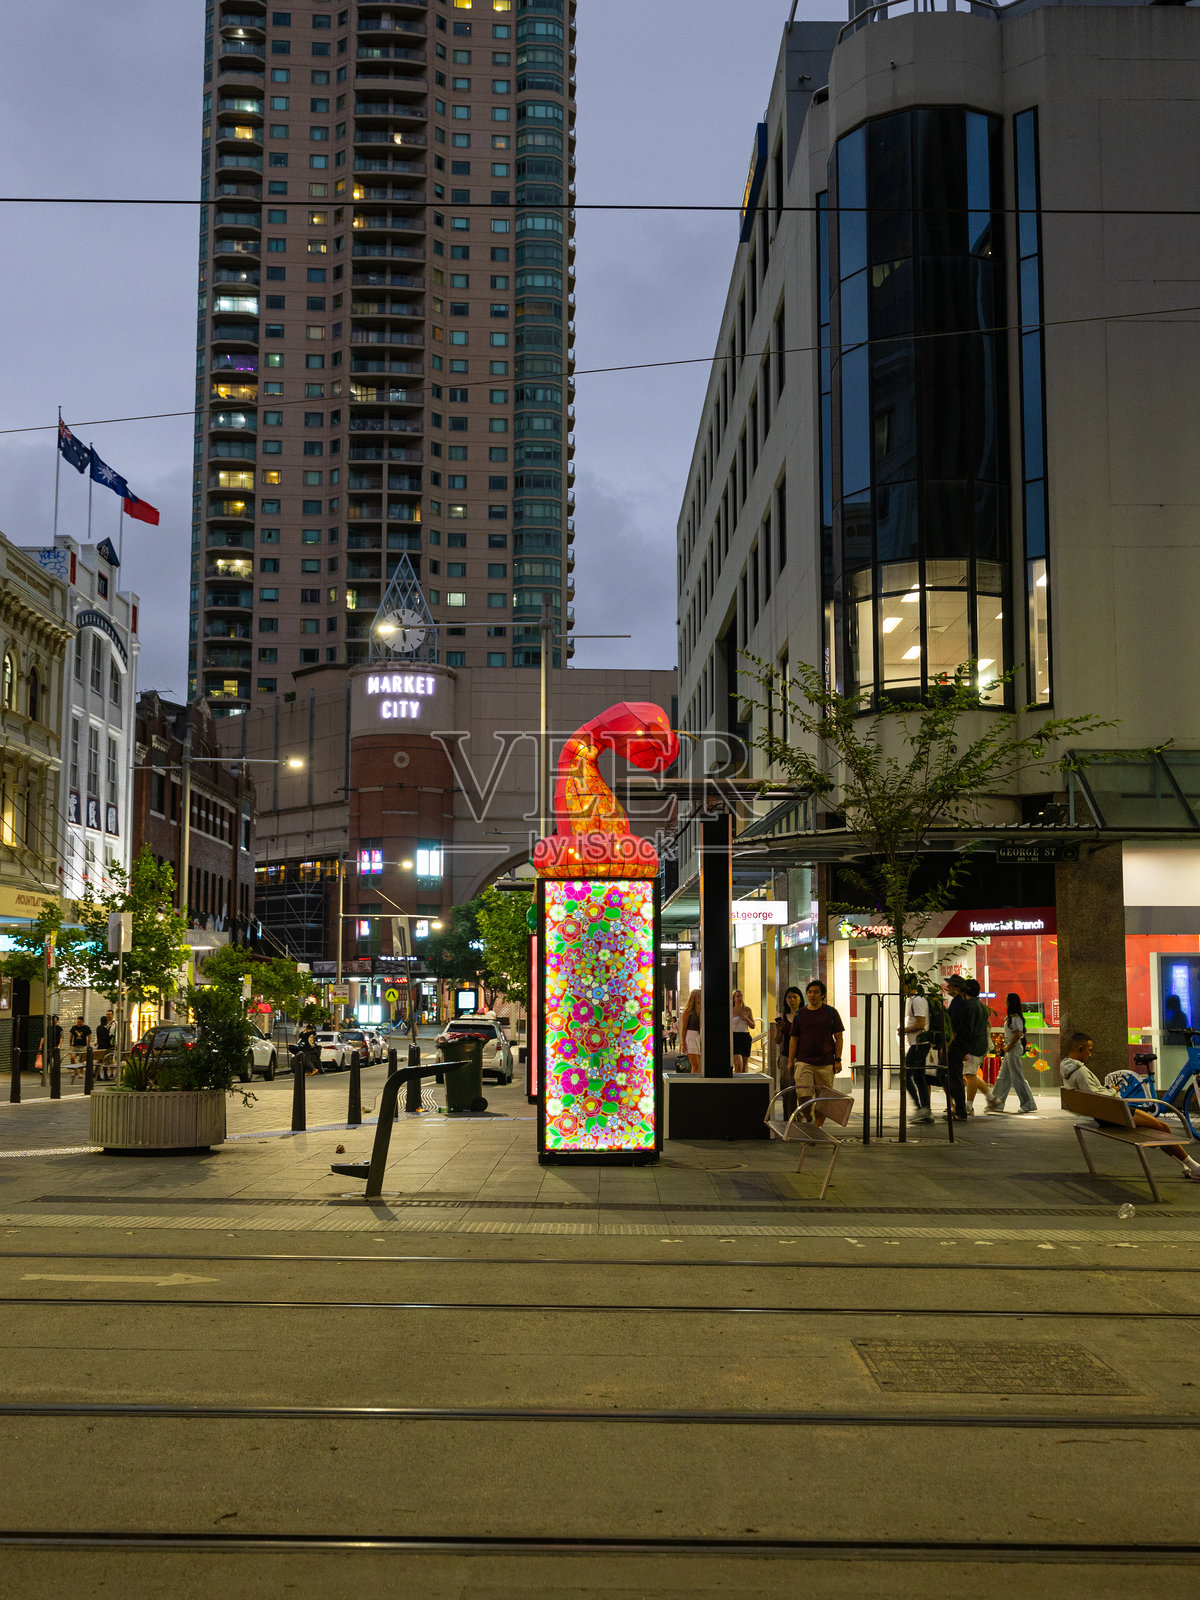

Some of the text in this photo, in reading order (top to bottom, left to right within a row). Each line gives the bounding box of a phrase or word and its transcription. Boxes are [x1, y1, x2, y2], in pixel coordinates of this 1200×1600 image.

[368, 675, 435, 694] MARKET
[382, 701, 420, 719] CITY
[999, 847, 1057, 857] GEORGE ST
[731, 910, 774, 921] st.george
[1014, 919, 1044, 930] Branch
